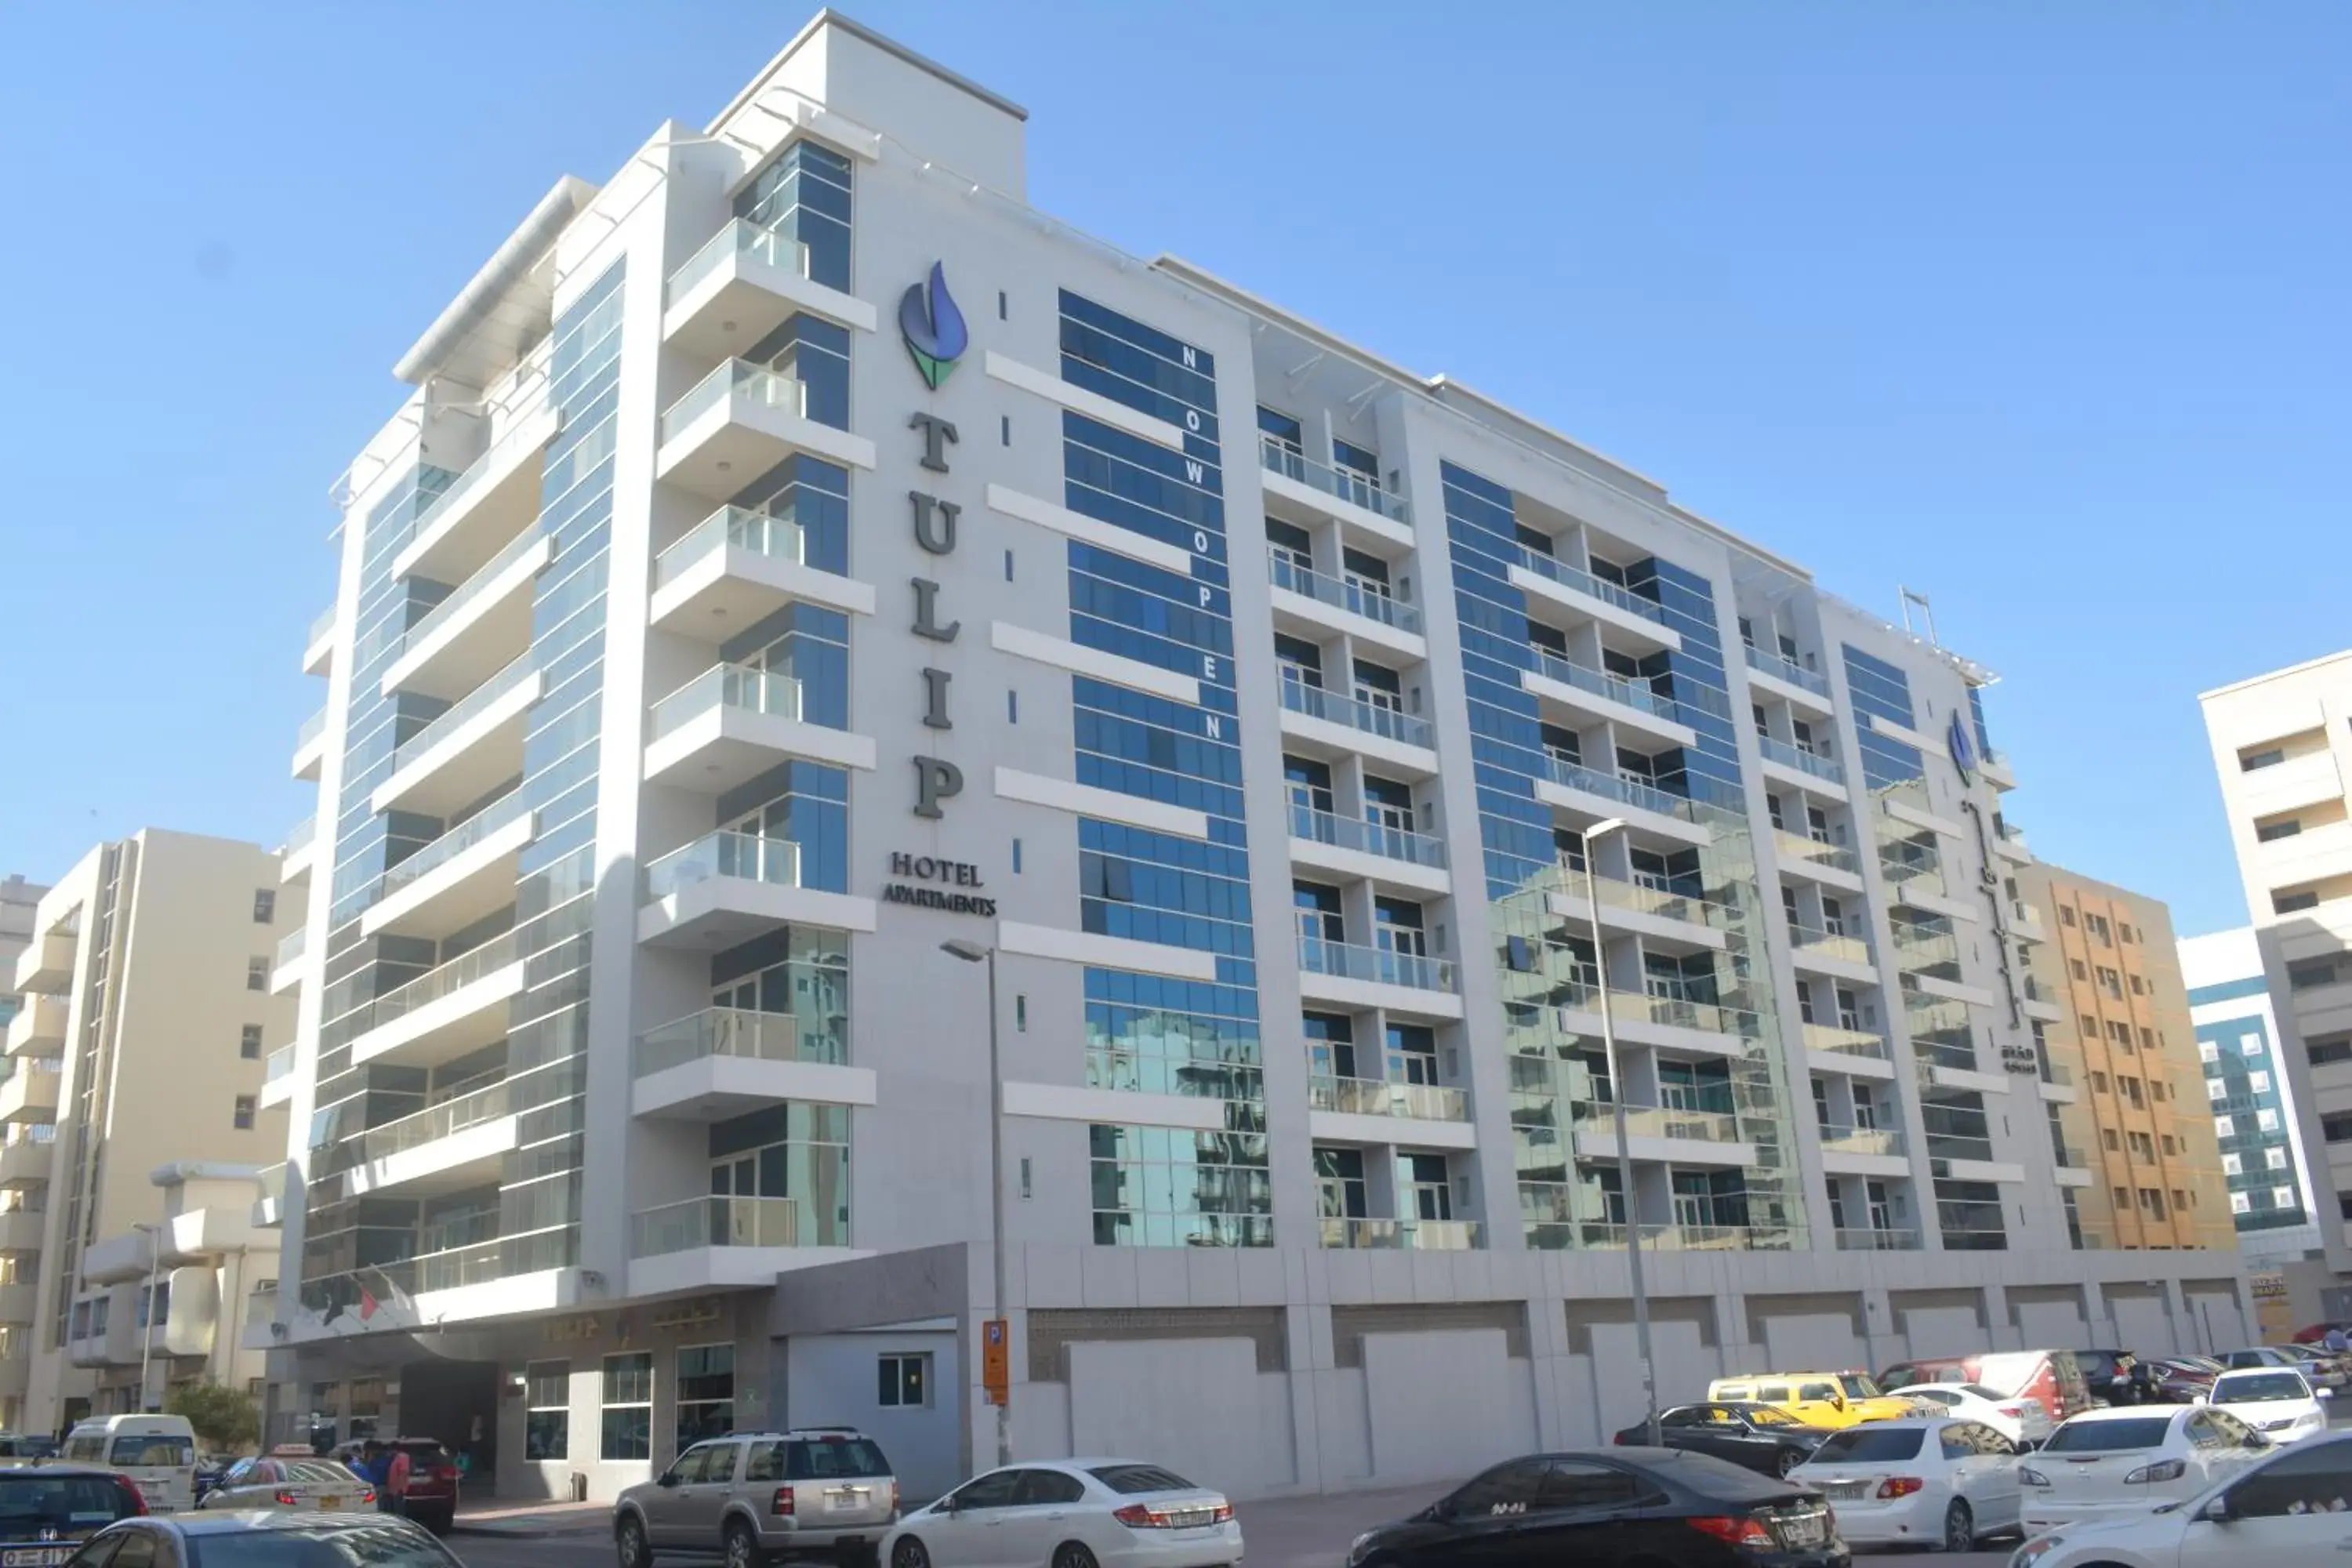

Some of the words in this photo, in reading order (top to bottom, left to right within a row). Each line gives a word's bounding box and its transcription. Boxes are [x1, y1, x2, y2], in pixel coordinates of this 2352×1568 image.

[908, 412, 964, 819] TULIP
[891, 851, 985, 887] HOTEL
[882, 883, 996, 917] APARTMENTS
